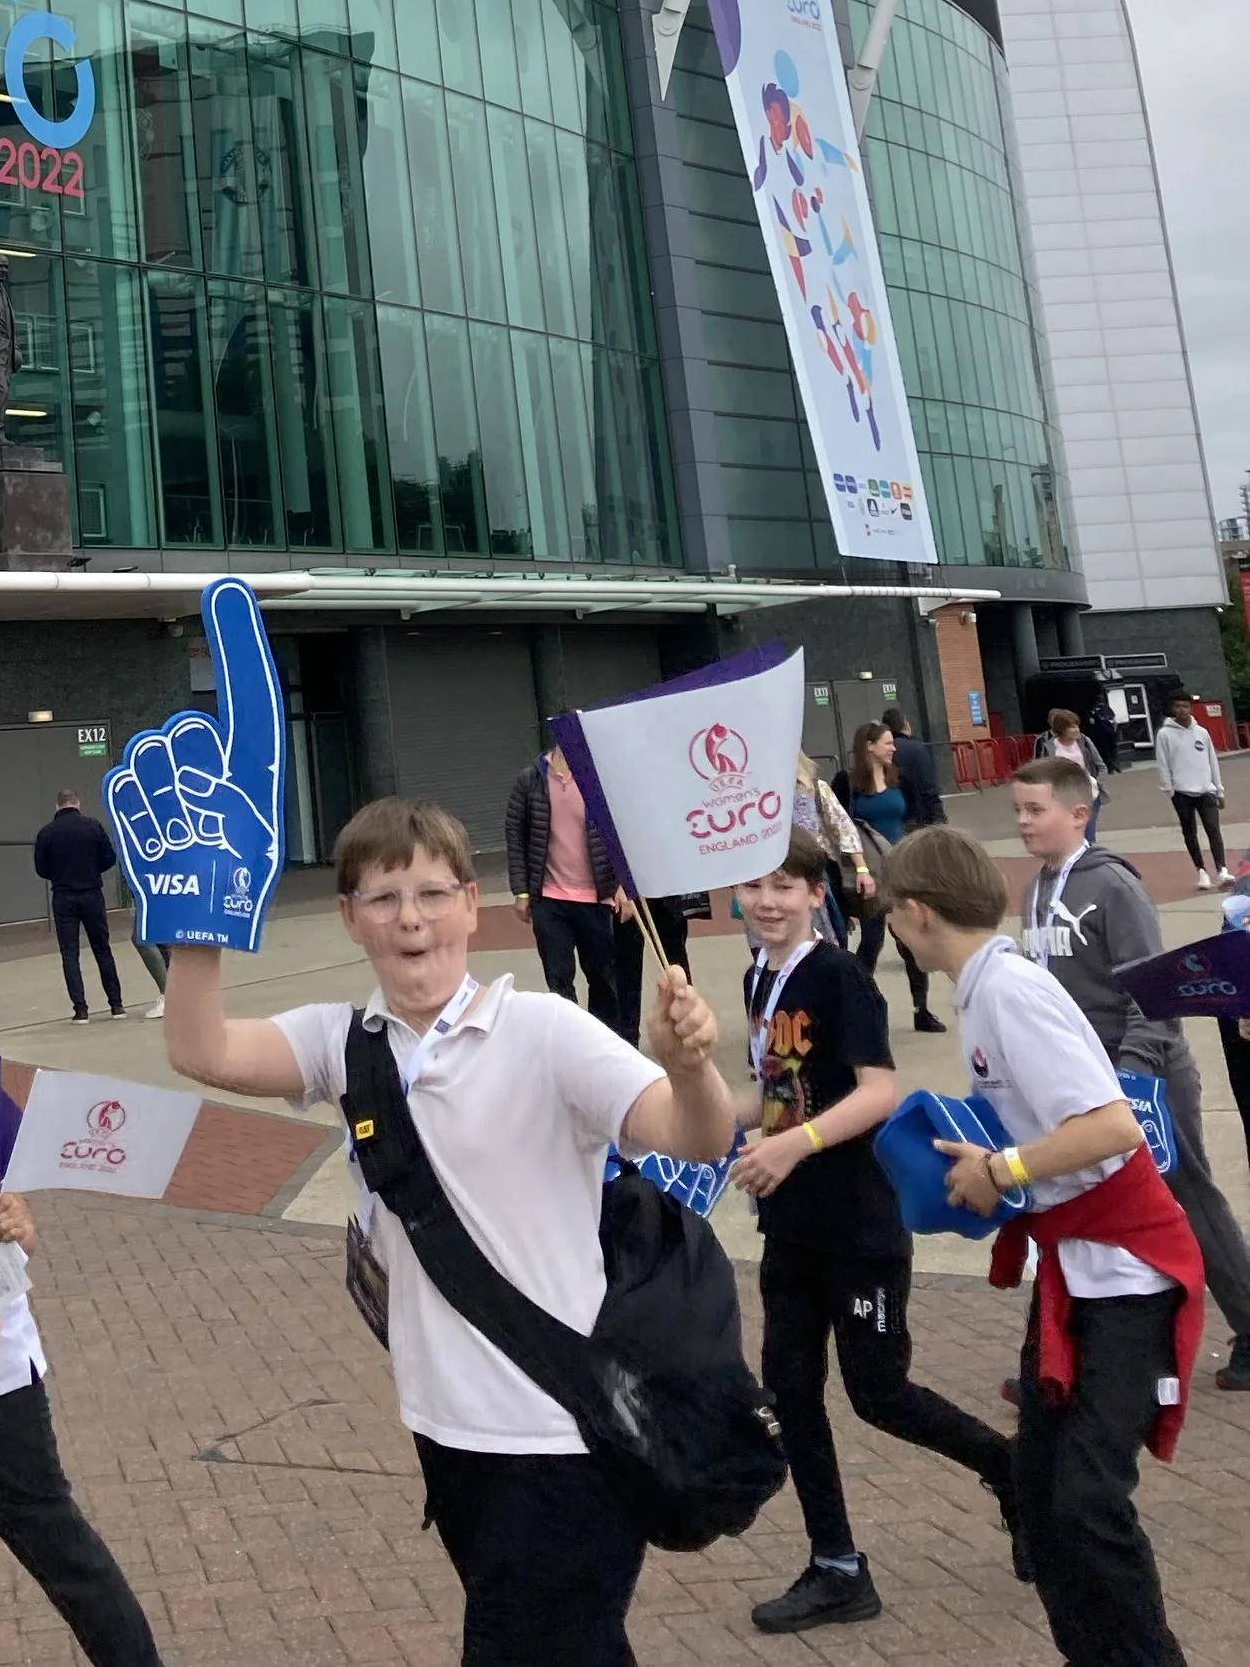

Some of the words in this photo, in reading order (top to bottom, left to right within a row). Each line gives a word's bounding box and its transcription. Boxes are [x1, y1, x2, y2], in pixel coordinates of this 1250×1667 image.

[77, 727, 107, 743] EX12
[698, 833, 759, 855] ENGLAND
[144, 873, 201, 896] VISA
[187, 930, 215, 941] UEFA
[1130, 1098, 1154, 1114] VIS
[853, 1297, 873, 1319] AP
